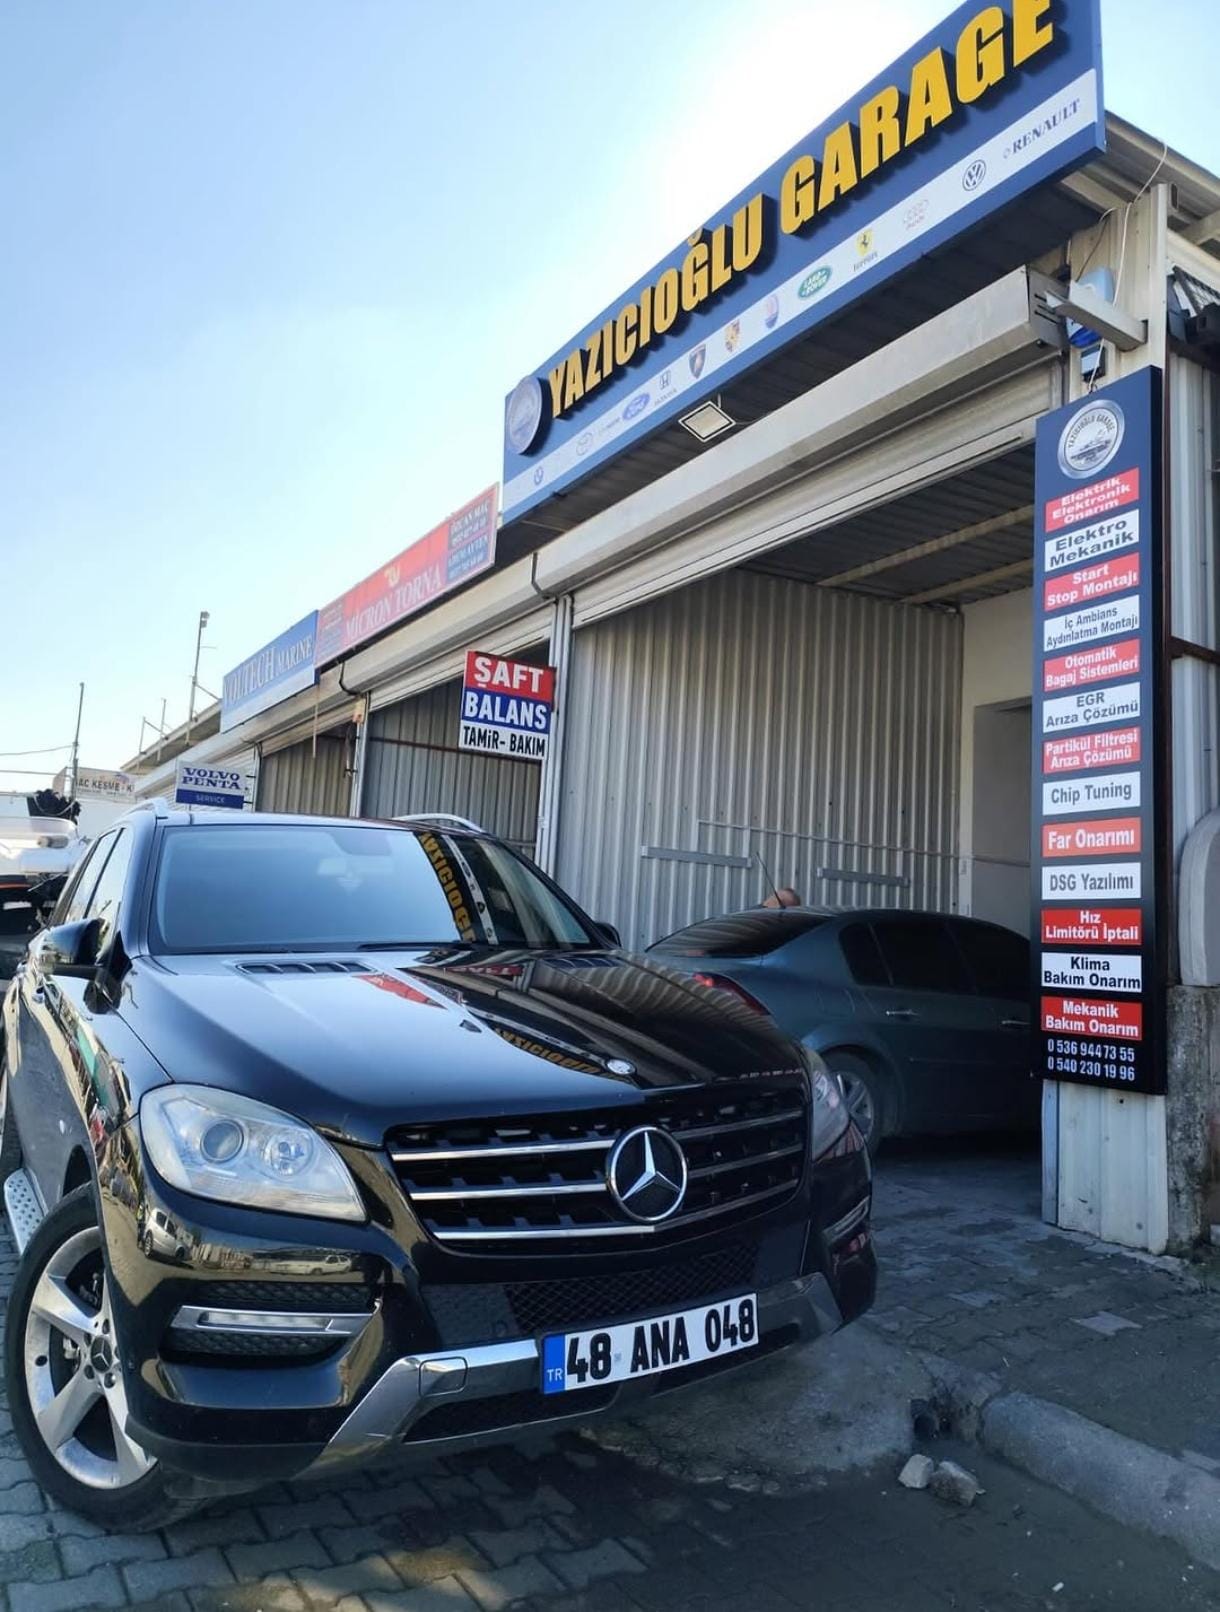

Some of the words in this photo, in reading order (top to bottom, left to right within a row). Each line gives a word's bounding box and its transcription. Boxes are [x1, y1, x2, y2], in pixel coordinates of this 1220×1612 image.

[1011, 98, 1081, 154] RENAULT
[549, 194, 764, 419] YAZICIOĞLU
[779, 0, 1054, 236] GARAGE
[1052, 484, 1131, 519] Elektronik
[1061, 477, 1121, 505] Elektrik
[1063, 499, 1120, 524] Onarım
[1055, 519, 1127, 552] Elektro
[1049, 532, 1134, 567] Mekanik
[1072, 564, 1109, 584] Start
[1047, 590, 1078, 607] Stop
[1083, 570, 1138, 596] Montajı
[1064, 615, 1074, 630] İç
[1076, 607, 1118, 626] Ambians
[1046, 627, 1098, 648] Aydınlatma
[1100, 614, 1138, 633] Montajı
[1065, 646, 1117, 669] Otomatik
[474, 656, 544, 693] ŞAFT
[1046, 670, 1077, 688] Bagaj
[1080, 656, 1138, 680] Sistemleri
[464, 691, 547, 730] BALANS
[1076, 692, 1105, 707] EGR
[1046, 714, 1079, 728] Arıza
[1083, 699, 1138, 723] Çözümü
[509, 734, 546, 757] BAKIM
[1046, 736, 1090, 756] Partikül
[1094, 729, 1138, 748] Filtresi
[1051, 754, 1080, 769] Arıza
[1083, 745, 1132, 767] Çözümü
[181, 776, 242, 790] PENTA
[183, 767, 241, 781] VOLVO
[1051, 786, 1080, 805] Chip
[1084, 782, 1132, 800] Tuning
[1048, 831, 1071, 850] Far
[1075, 829, 1135, 848] Onarımı
[1050, 873, 1077, 891] DSG
[1081, 872, 1134, 890] Yazılımı
[1080, 910, 1101, 924] Hız
[1045, 925, 1099, 939] Limitörü
[1103, 923, 1139, 942] İptali
[1071, 956, 1111, 971] Klima
[1044, 970, 1085, 986] Bakım
[1089, 973, 1141, 989] Onarım
[1063, 1000, 1119, 1018] Mekanik
[1045, 1015, 1085, 1032] Bakım
[1088, 1019, 1139, 1037] Onarım
[1047, 1039, 1054, 1052] 0
[1056, 1039, 1078, 1055] 536
[1119, 1047, 1135, 1062] 55
[1047, 1057, 1054, 1070] 0
[1056, 1058, 1077, 1073] 540
[1080, 1060, 1101, 1077] 230
[1103, 1064, 1116, 1079] 19
[1119, 1066, 1135, 1081] 96
[566, 1332, 612, 1383] 48
[630, 1316, 690, 1373] ANA
[704, 1298, 755, 1353] 048
[546, 1367, 564, 1382] TR
